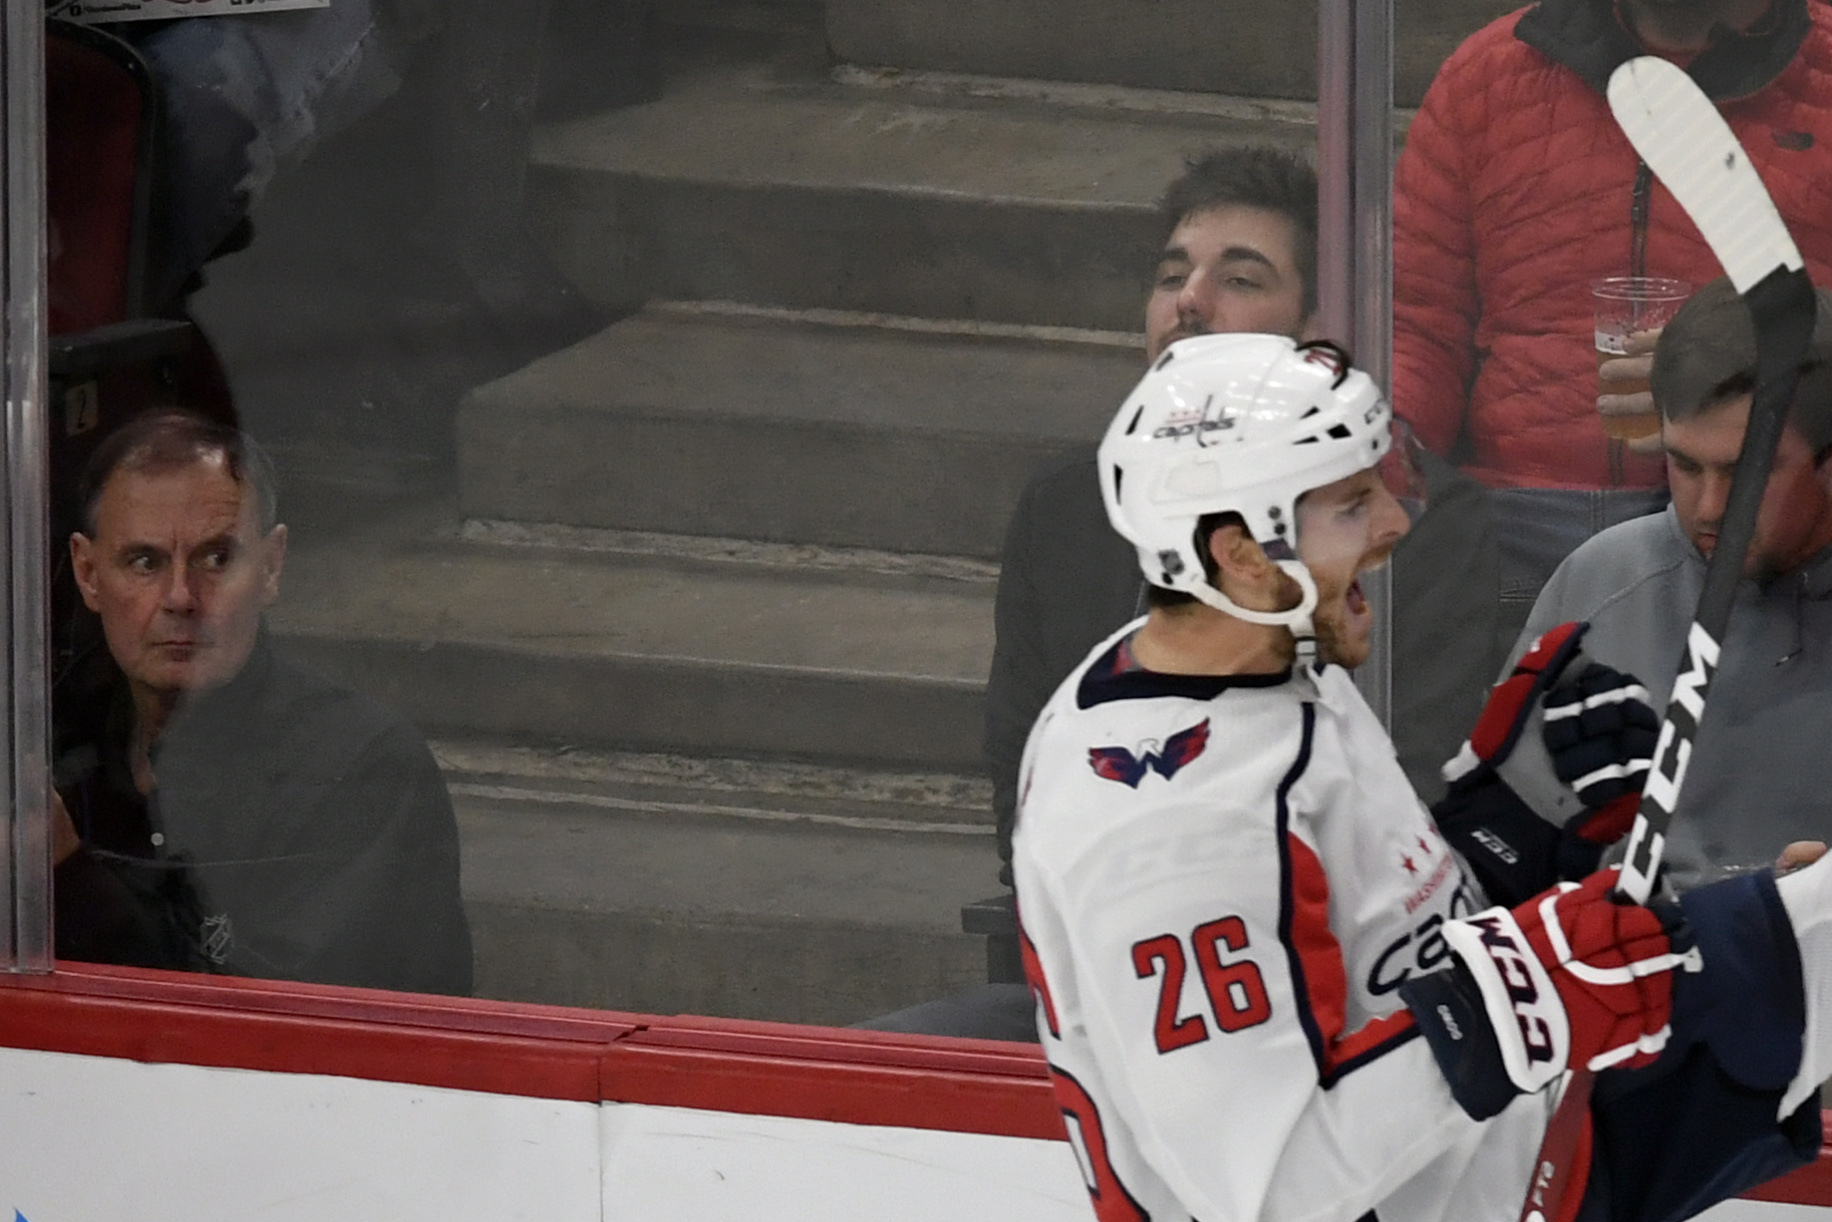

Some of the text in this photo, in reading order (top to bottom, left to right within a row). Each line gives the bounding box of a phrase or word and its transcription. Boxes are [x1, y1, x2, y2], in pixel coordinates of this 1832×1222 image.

[1615, 620, 1721, 906] CCM
[1131, 914, 1272, 1055] 26
[1466, 916, 1554, 1070] CCM
